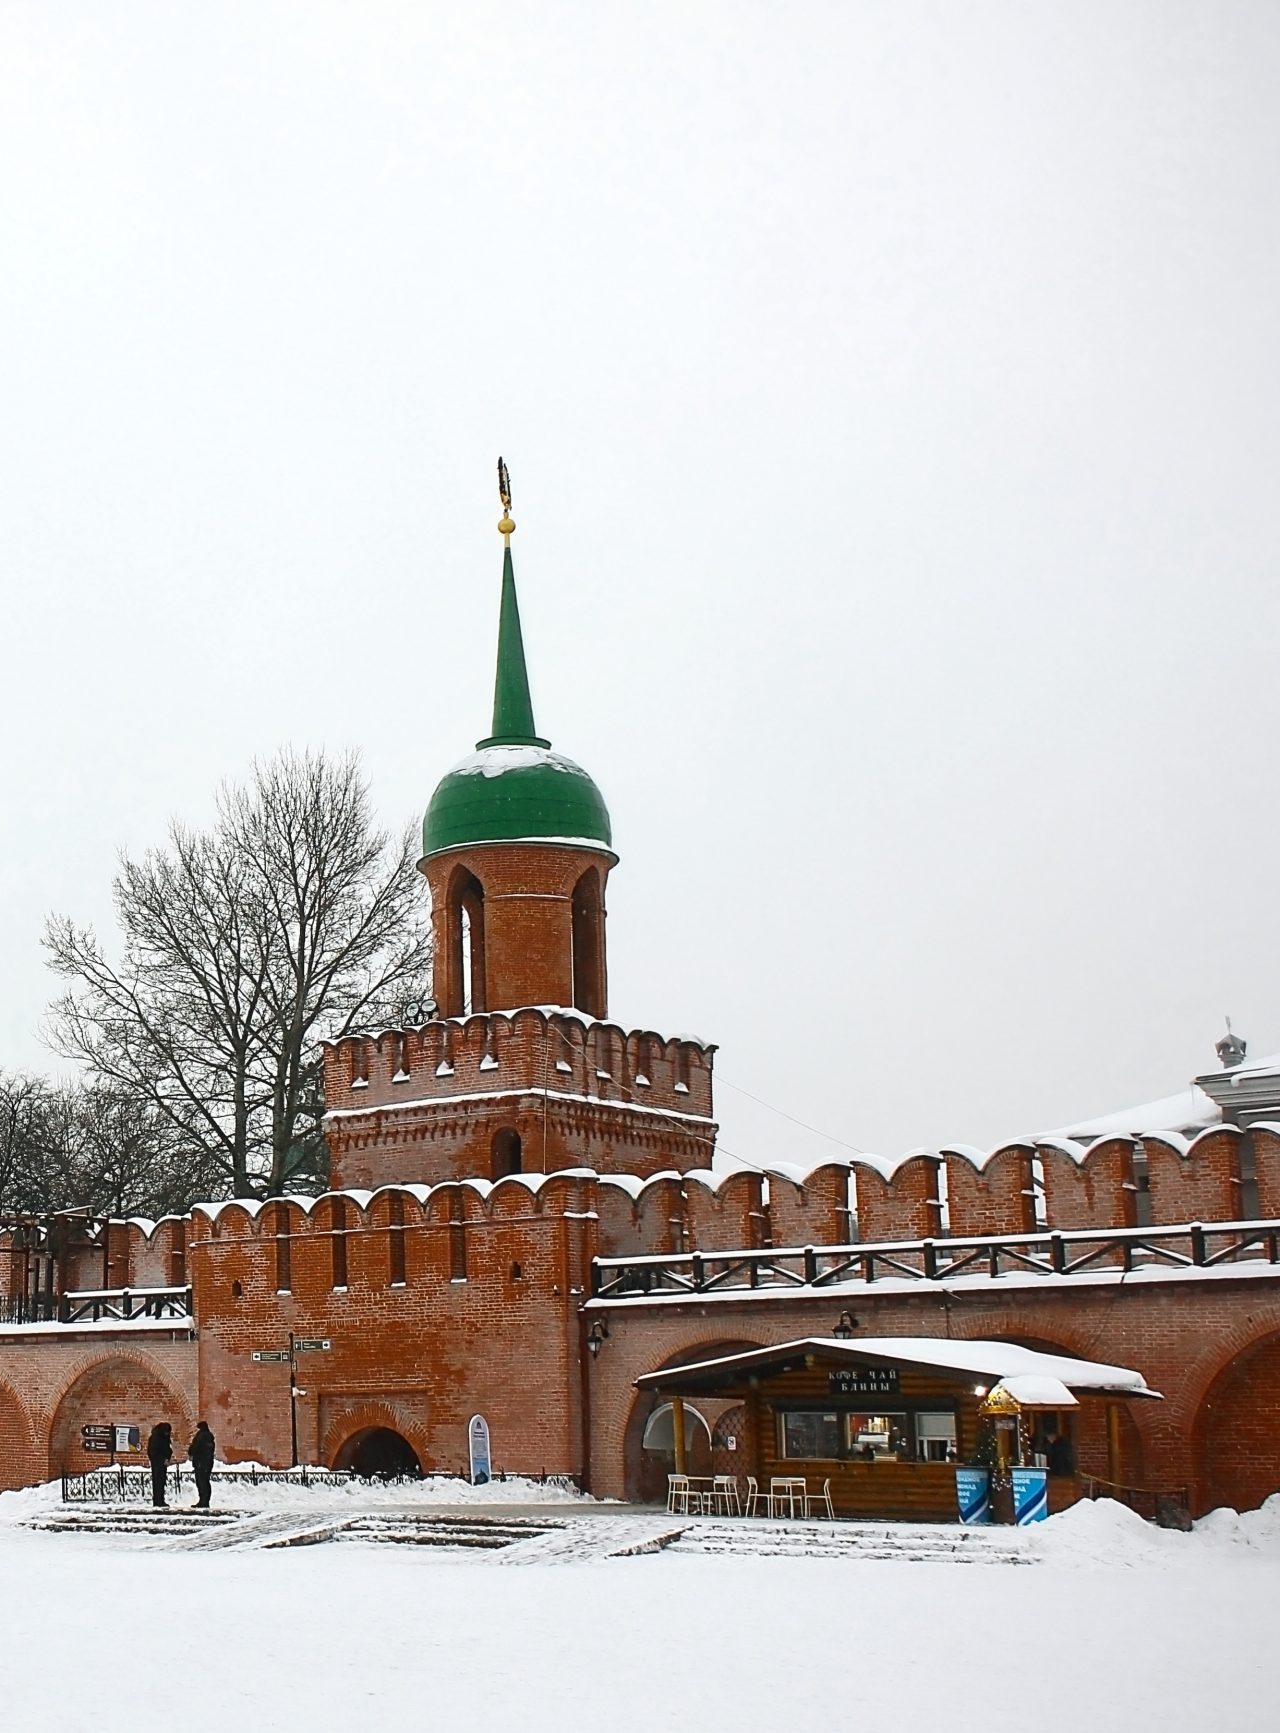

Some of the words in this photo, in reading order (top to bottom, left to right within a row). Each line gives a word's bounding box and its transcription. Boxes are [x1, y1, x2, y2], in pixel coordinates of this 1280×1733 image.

[828, 1371, 858, 1380] КОФЕ
[869, 1369, 897, 1380] ЧАЙ
[841, 1382, 890, 1391] БЛИНЫ
